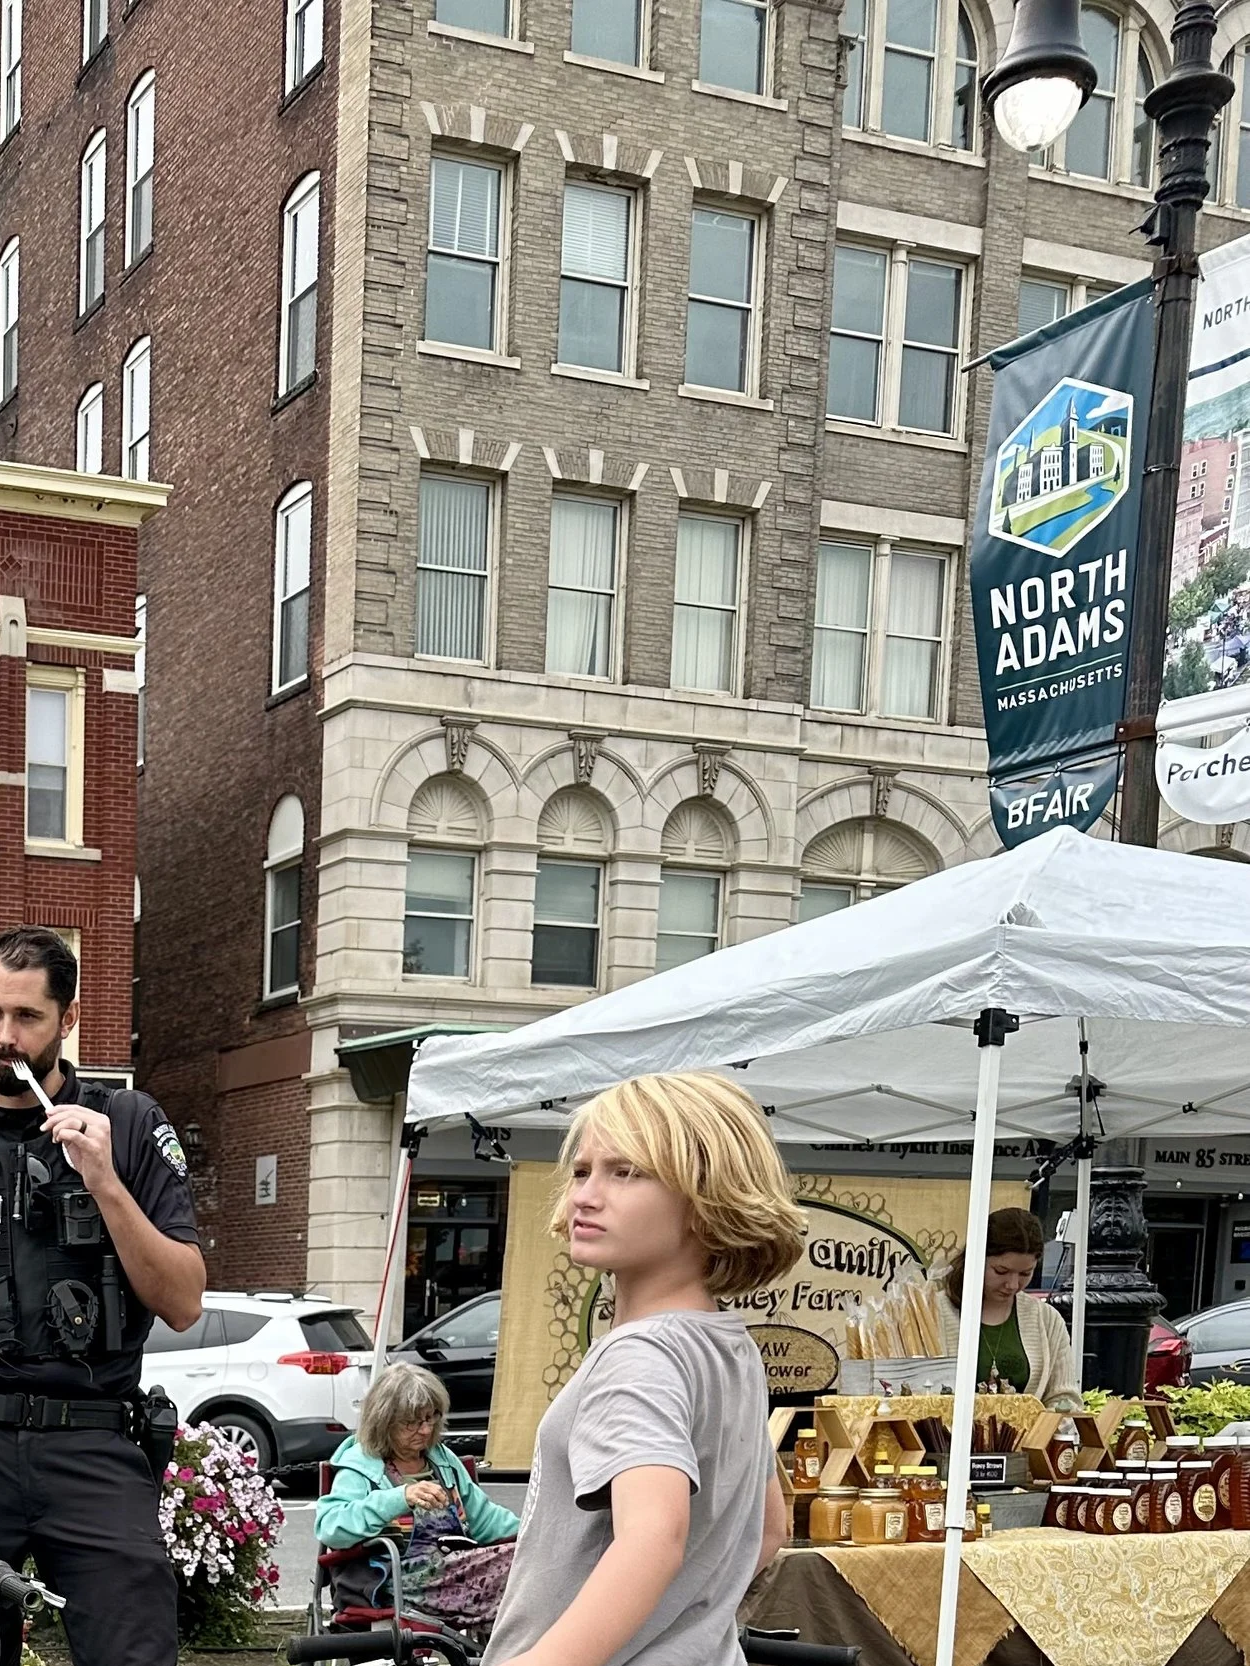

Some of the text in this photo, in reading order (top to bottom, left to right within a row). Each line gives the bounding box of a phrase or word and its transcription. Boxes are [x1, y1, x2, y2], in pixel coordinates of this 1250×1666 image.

[989, 548, 1127, 629] NORTH
[995, 599, 1126, 676] ADAMS
[997, 662, 1123, 711] MASSACHUSETTS
[1007, 782, 1095, 830] BFAIR
[1154, 1150, 1190, 1164] MAIN
[1195, 1148, 1216, 1168] 85
[798, 1225, 913, 1292] amily
